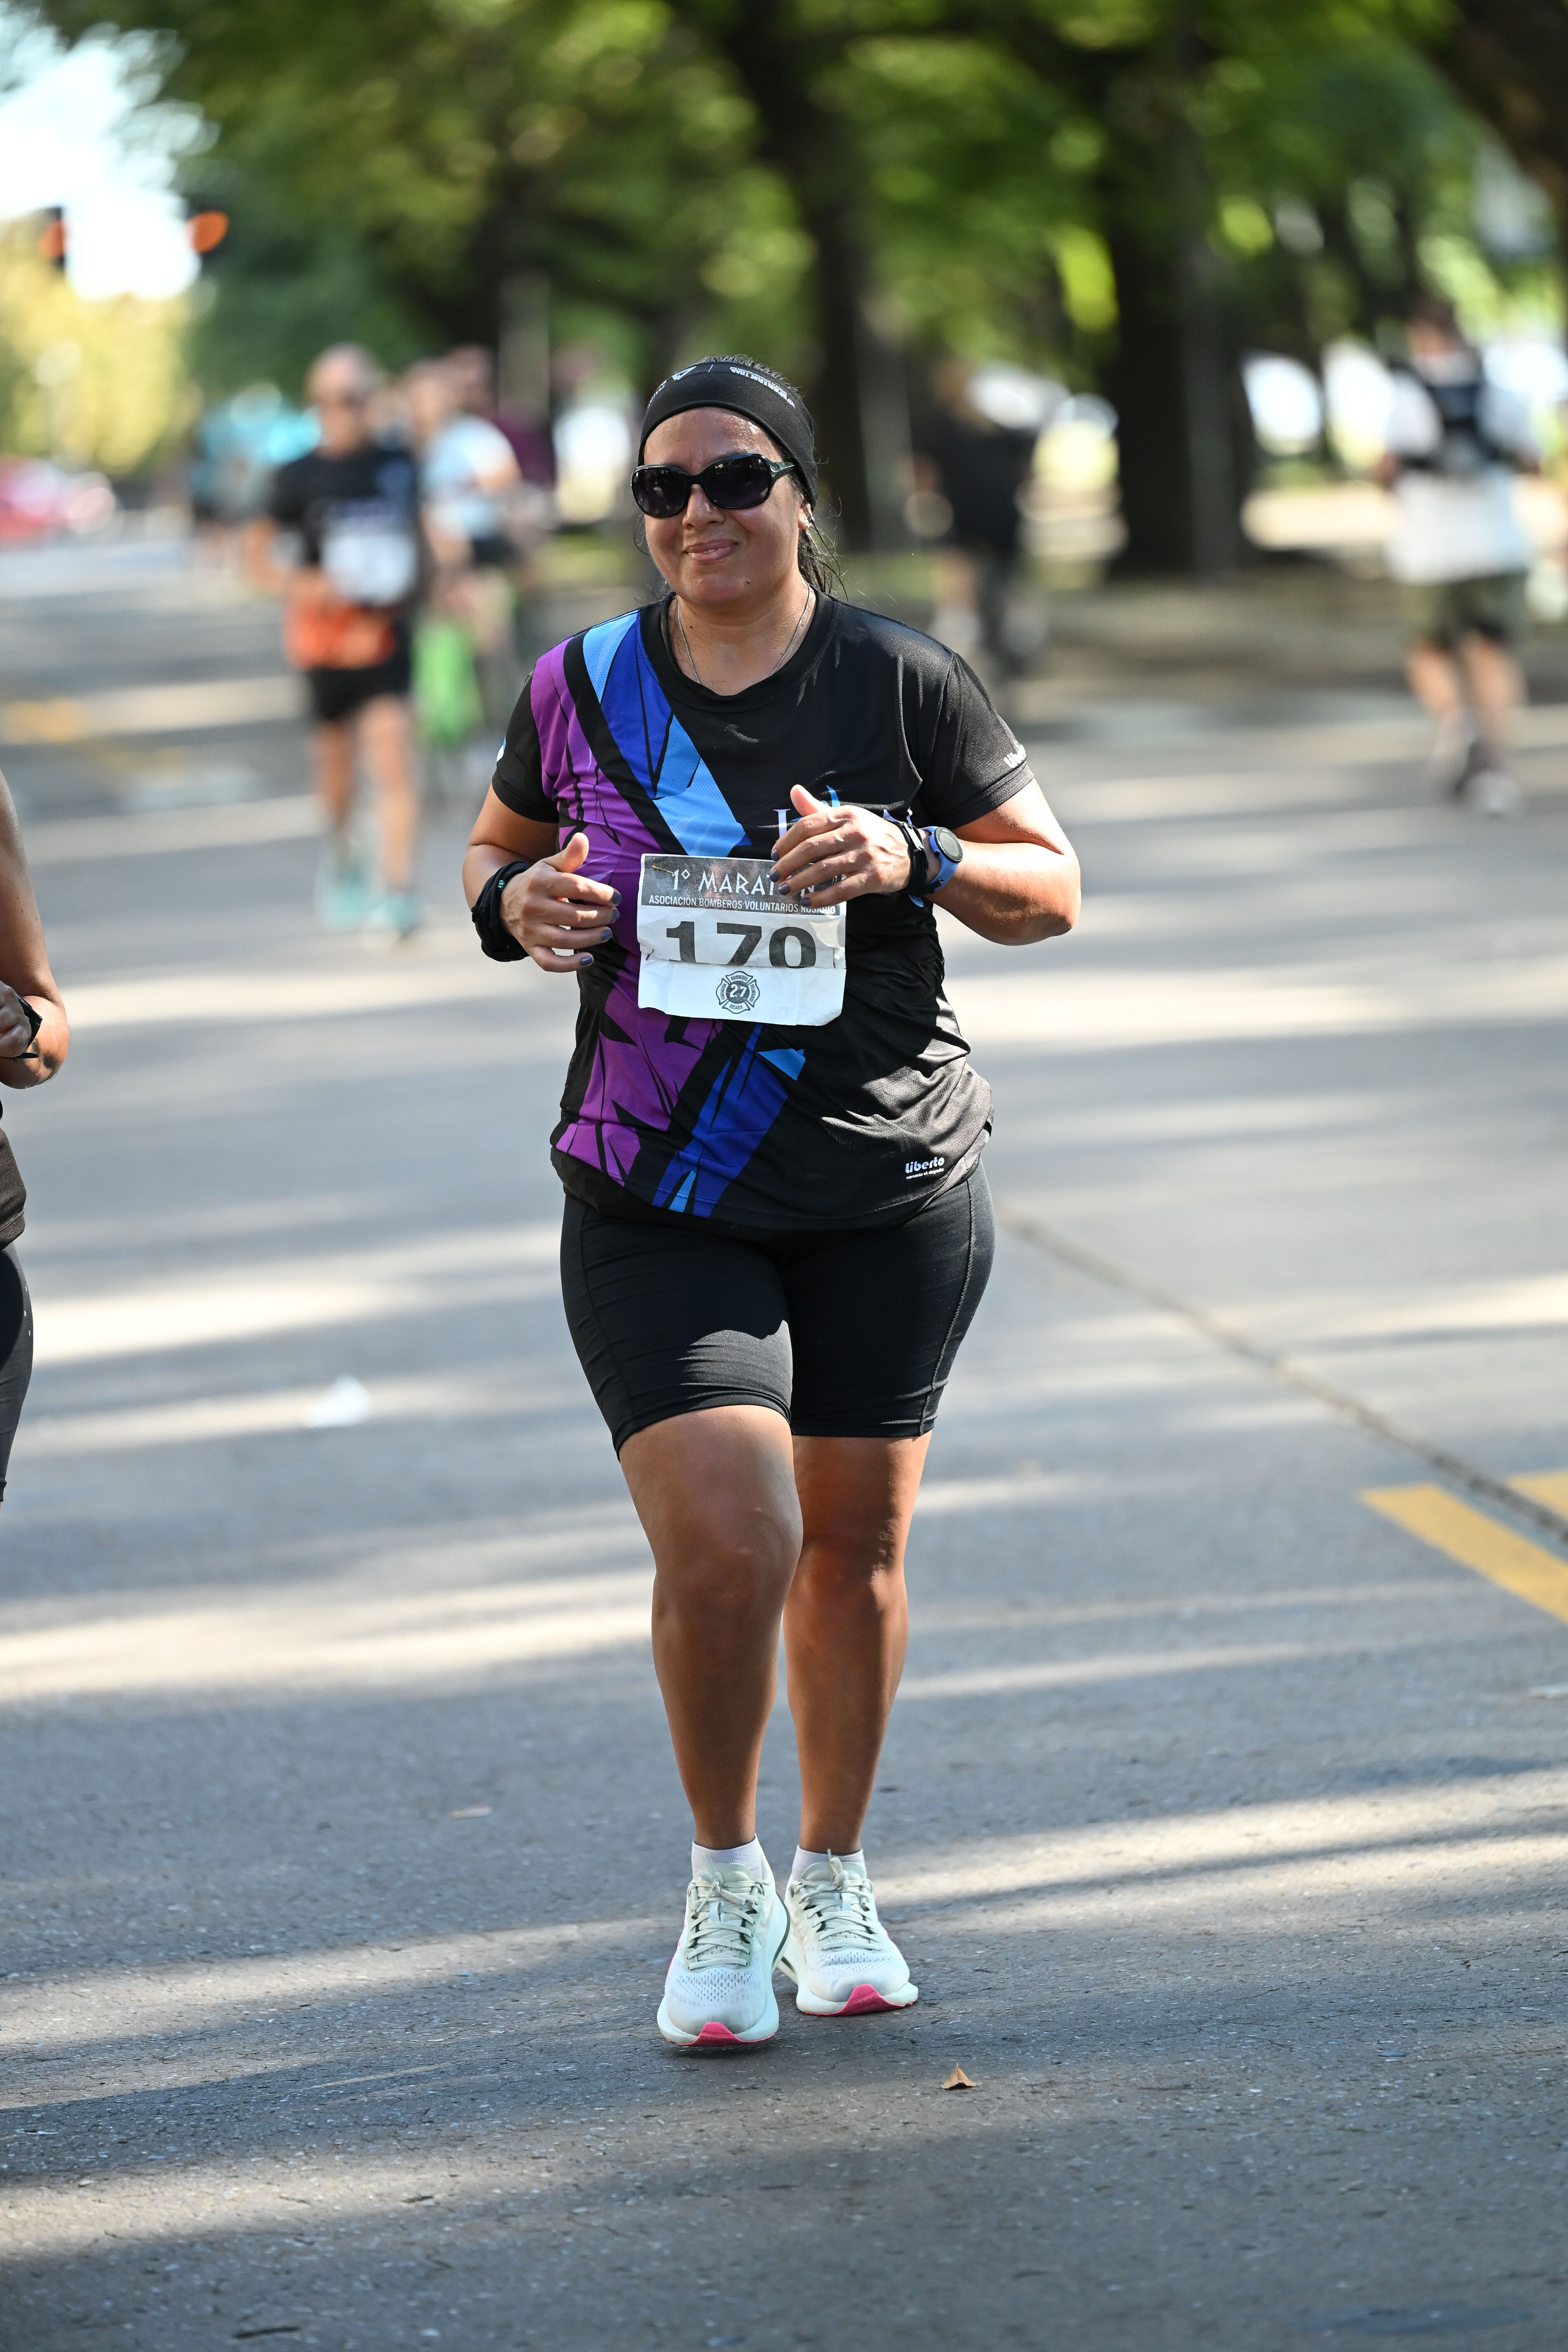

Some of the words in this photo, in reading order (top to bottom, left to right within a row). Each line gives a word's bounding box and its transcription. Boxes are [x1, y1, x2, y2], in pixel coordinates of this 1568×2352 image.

[649, 895, 696, 906] ASOCIACIÓN
[699, 898, 742, 909] BOMBEROS
[745, 901, 798, 913] VOLUNTARIOS
[666, 921, 816, 969] 170
[730, 984, 747, 998] 27
